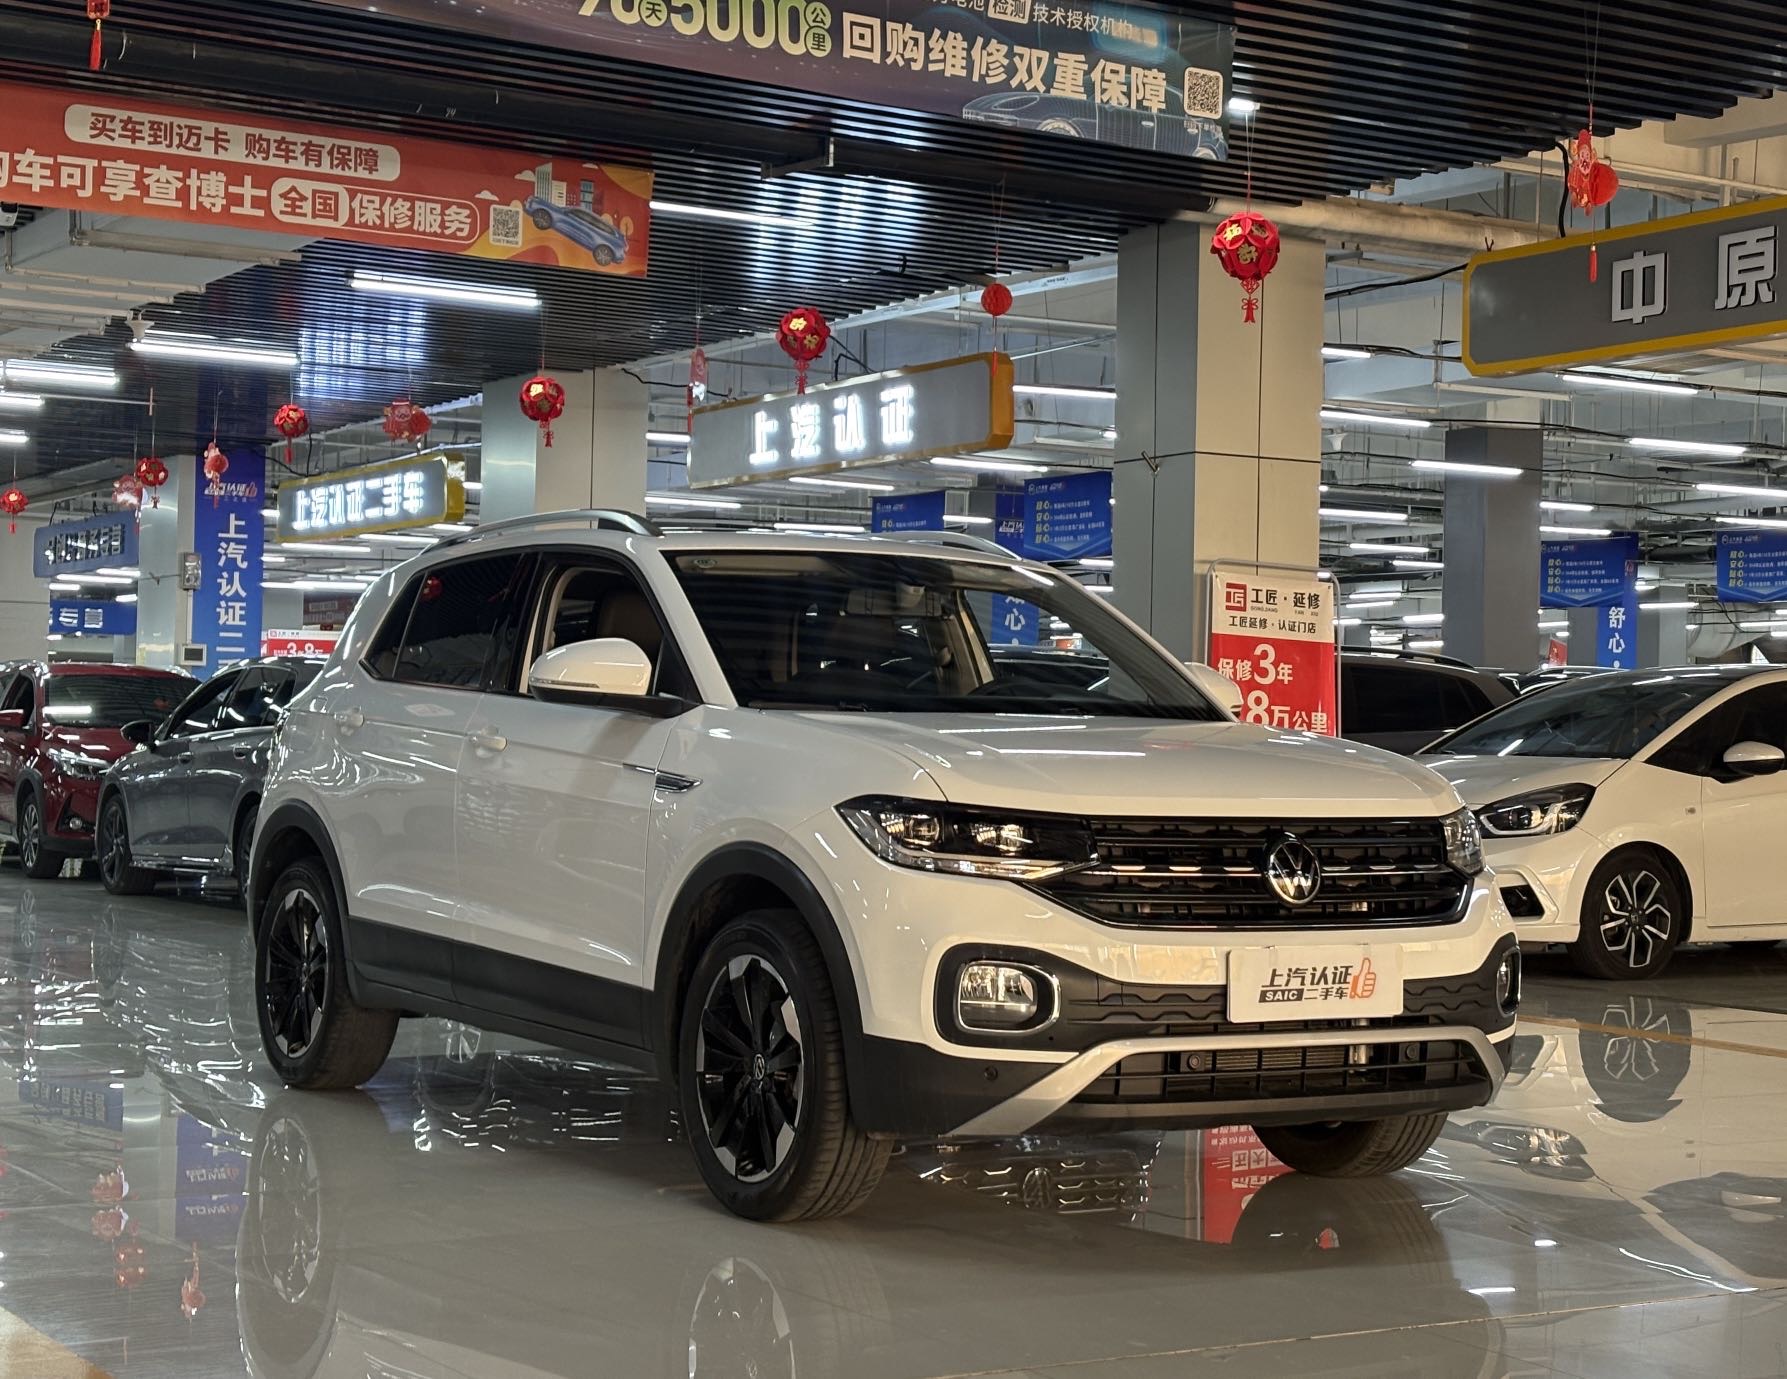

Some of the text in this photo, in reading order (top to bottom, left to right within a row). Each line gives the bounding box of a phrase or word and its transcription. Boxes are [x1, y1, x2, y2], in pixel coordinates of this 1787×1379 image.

[842, 12, 1166, 113] 回购维修双重保障
[89, 112, 379, 175] 买车到迈卡 购车有保障
[1611, 225, 1777, 324] 中原
[749, 384, 914, 466] 上汽认证
[292, 471, 424, 530] 上汽认证二手车
[216, 513, 248, 669] 上汽认证二
[1218, 643, 1293, 685] 保修3年
[1246, 690, 1327, 733] 8万公里
[1261, 965, 1353, 988] 上汽认证
[1265, 986, 1349, 1001] SAIC 二手车
